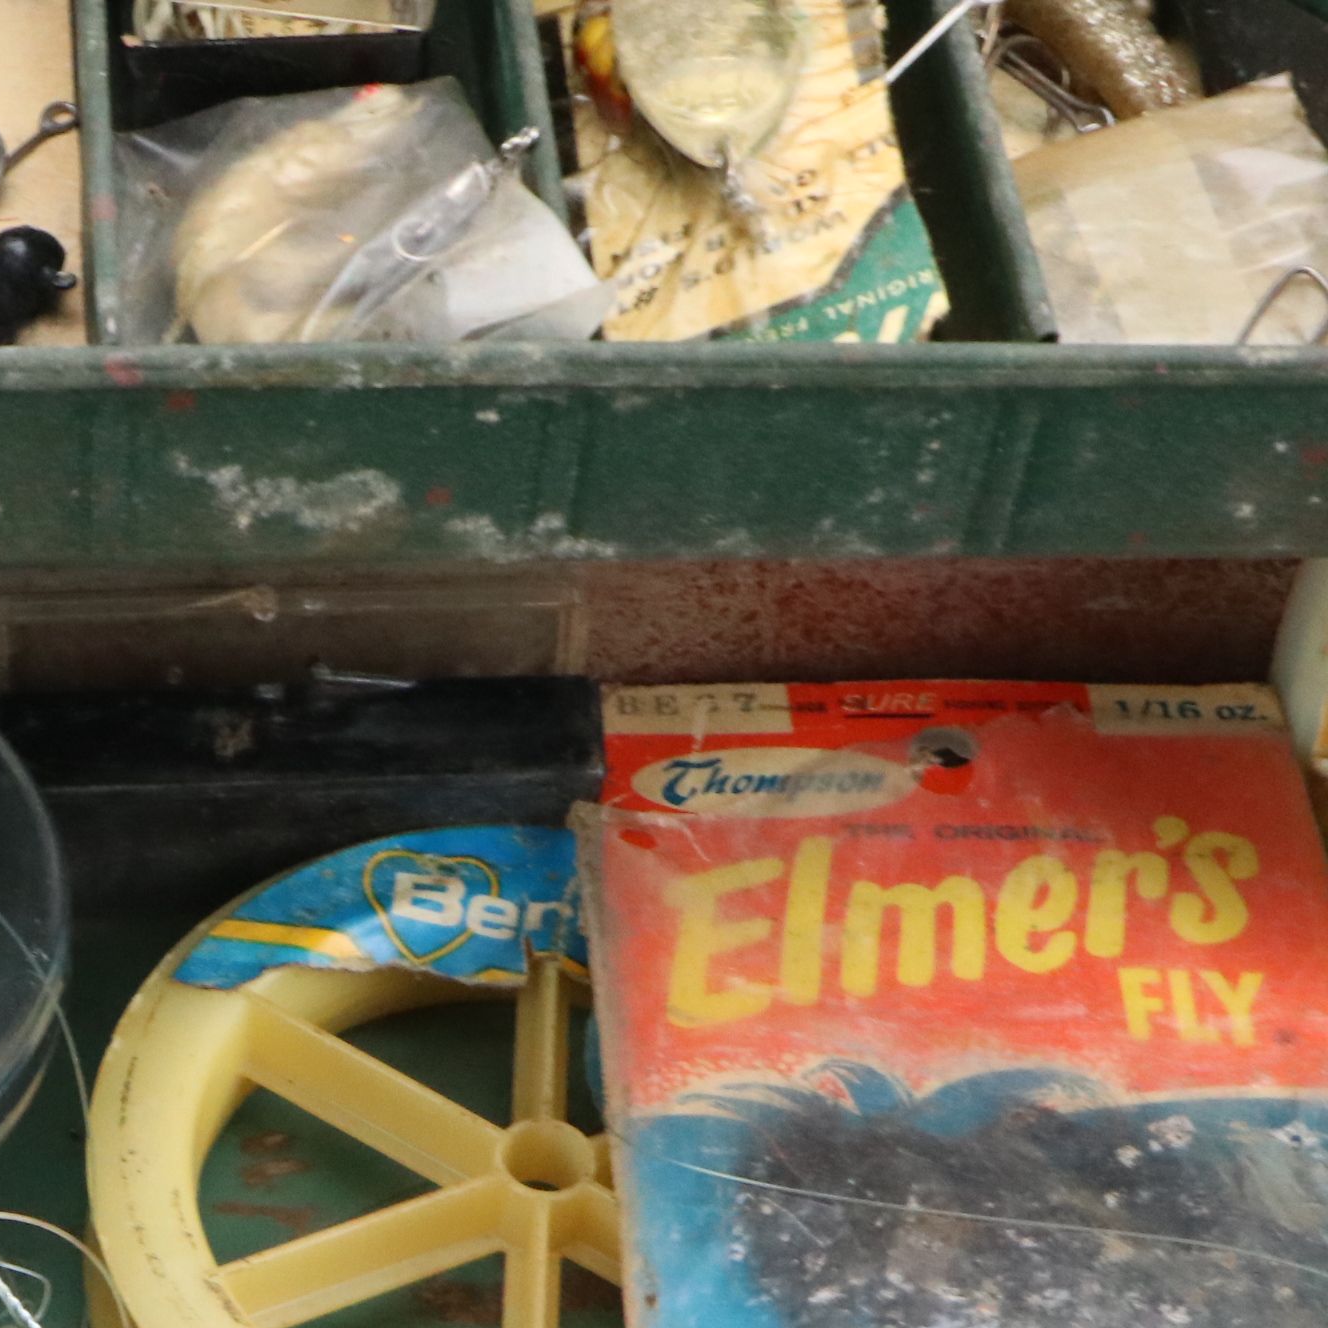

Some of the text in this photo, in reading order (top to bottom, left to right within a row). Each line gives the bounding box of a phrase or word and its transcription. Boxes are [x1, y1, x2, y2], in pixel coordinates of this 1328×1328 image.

[1113, 698, 1269, 722] 1/16 oz.
[660, 756, 886, 806] Thompson
[931, 822, 1102, 843] ORIGINAL
[665, 815, 1262, 1030] Elmer's
[1117, 965, 1265, 1048] FLY
